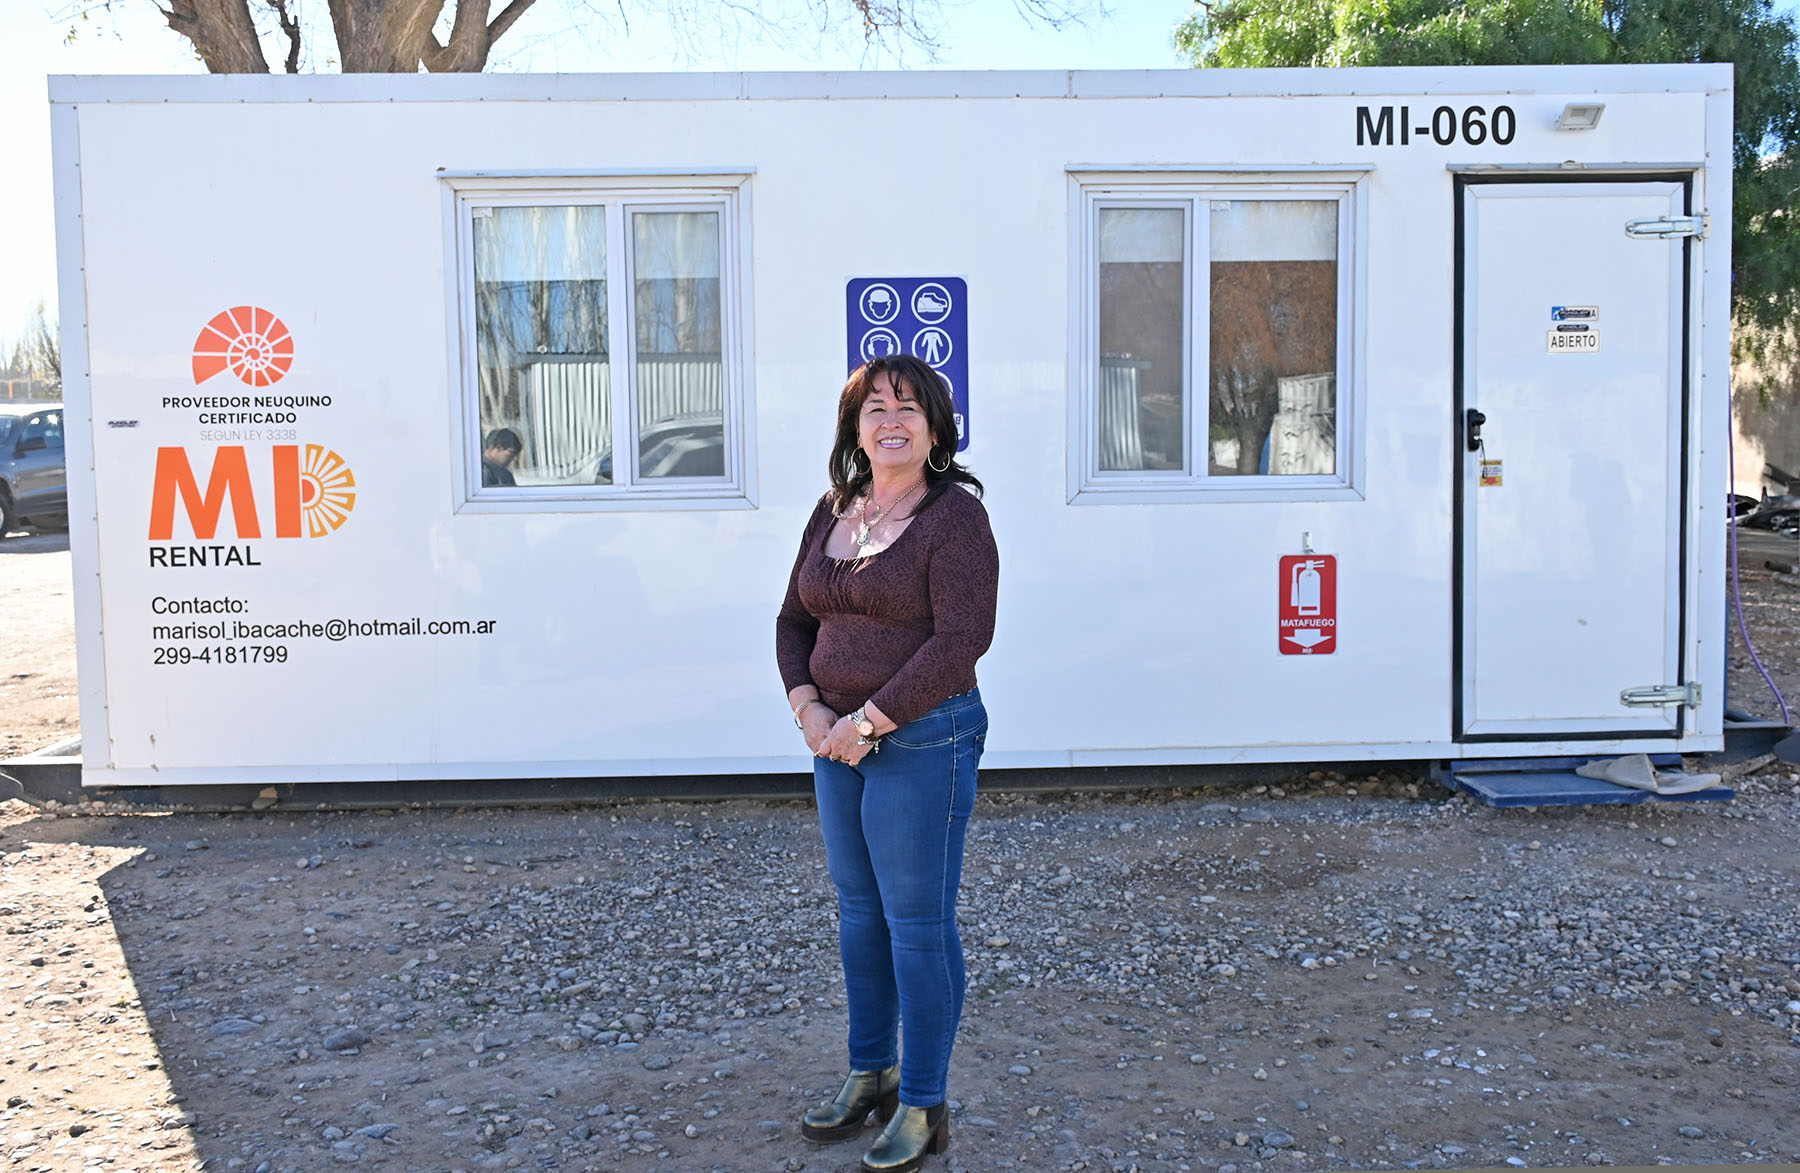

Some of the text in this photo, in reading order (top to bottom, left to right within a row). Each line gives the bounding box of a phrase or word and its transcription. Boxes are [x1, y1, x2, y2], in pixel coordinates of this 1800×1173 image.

[1356, 105, 1517, 146] MI-060
[1551, 335, 1596, 348] ABIERTO
[162, 395, 332, 409] PROVEEDOR NEUQUINO
[199, 412, 297, 425] CERTIFICADO
[200, 429, 297, 441] SEGUN LEY 3338
[149, 546, 261, 567] RENTAL
[152, 597, 249, 615] Contacto:
[152, 618, 496, 642] marisol_ibacache@hotmail.com.ar
[1280, 618, 1335, 627] MATAFUEGO
[154, 646, 288, 665] 299-4181799
